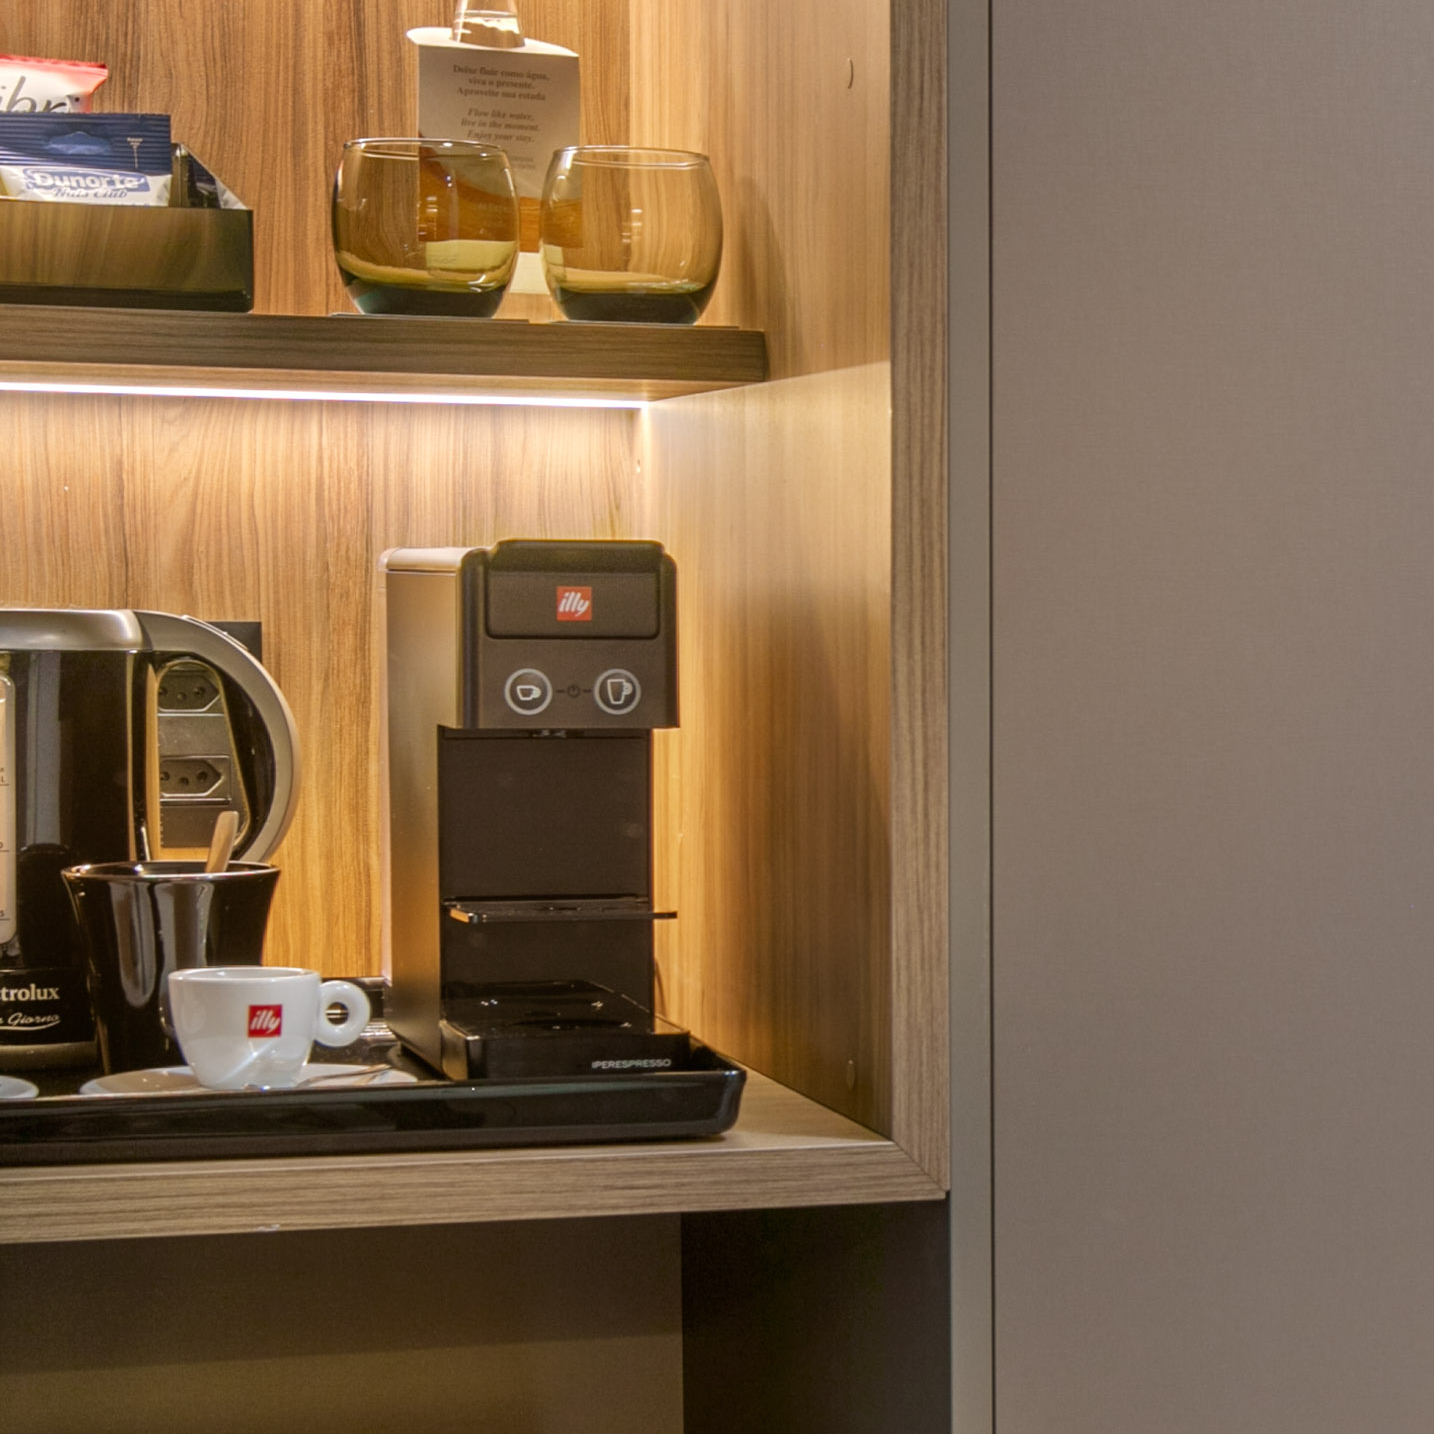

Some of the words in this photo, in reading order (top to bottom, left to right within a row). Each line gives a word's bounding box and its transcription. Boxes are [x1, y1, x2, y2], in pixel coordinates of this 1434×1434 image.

[501, 69, 524, 78] como
[33, 172, 144, 190] Dunorte
[94, 188, 128, 199] Club
[558, 591, 590, 617] illy
[0, 983, 60, 1001] trolux
[250, 1010, 281, 1035] illy
